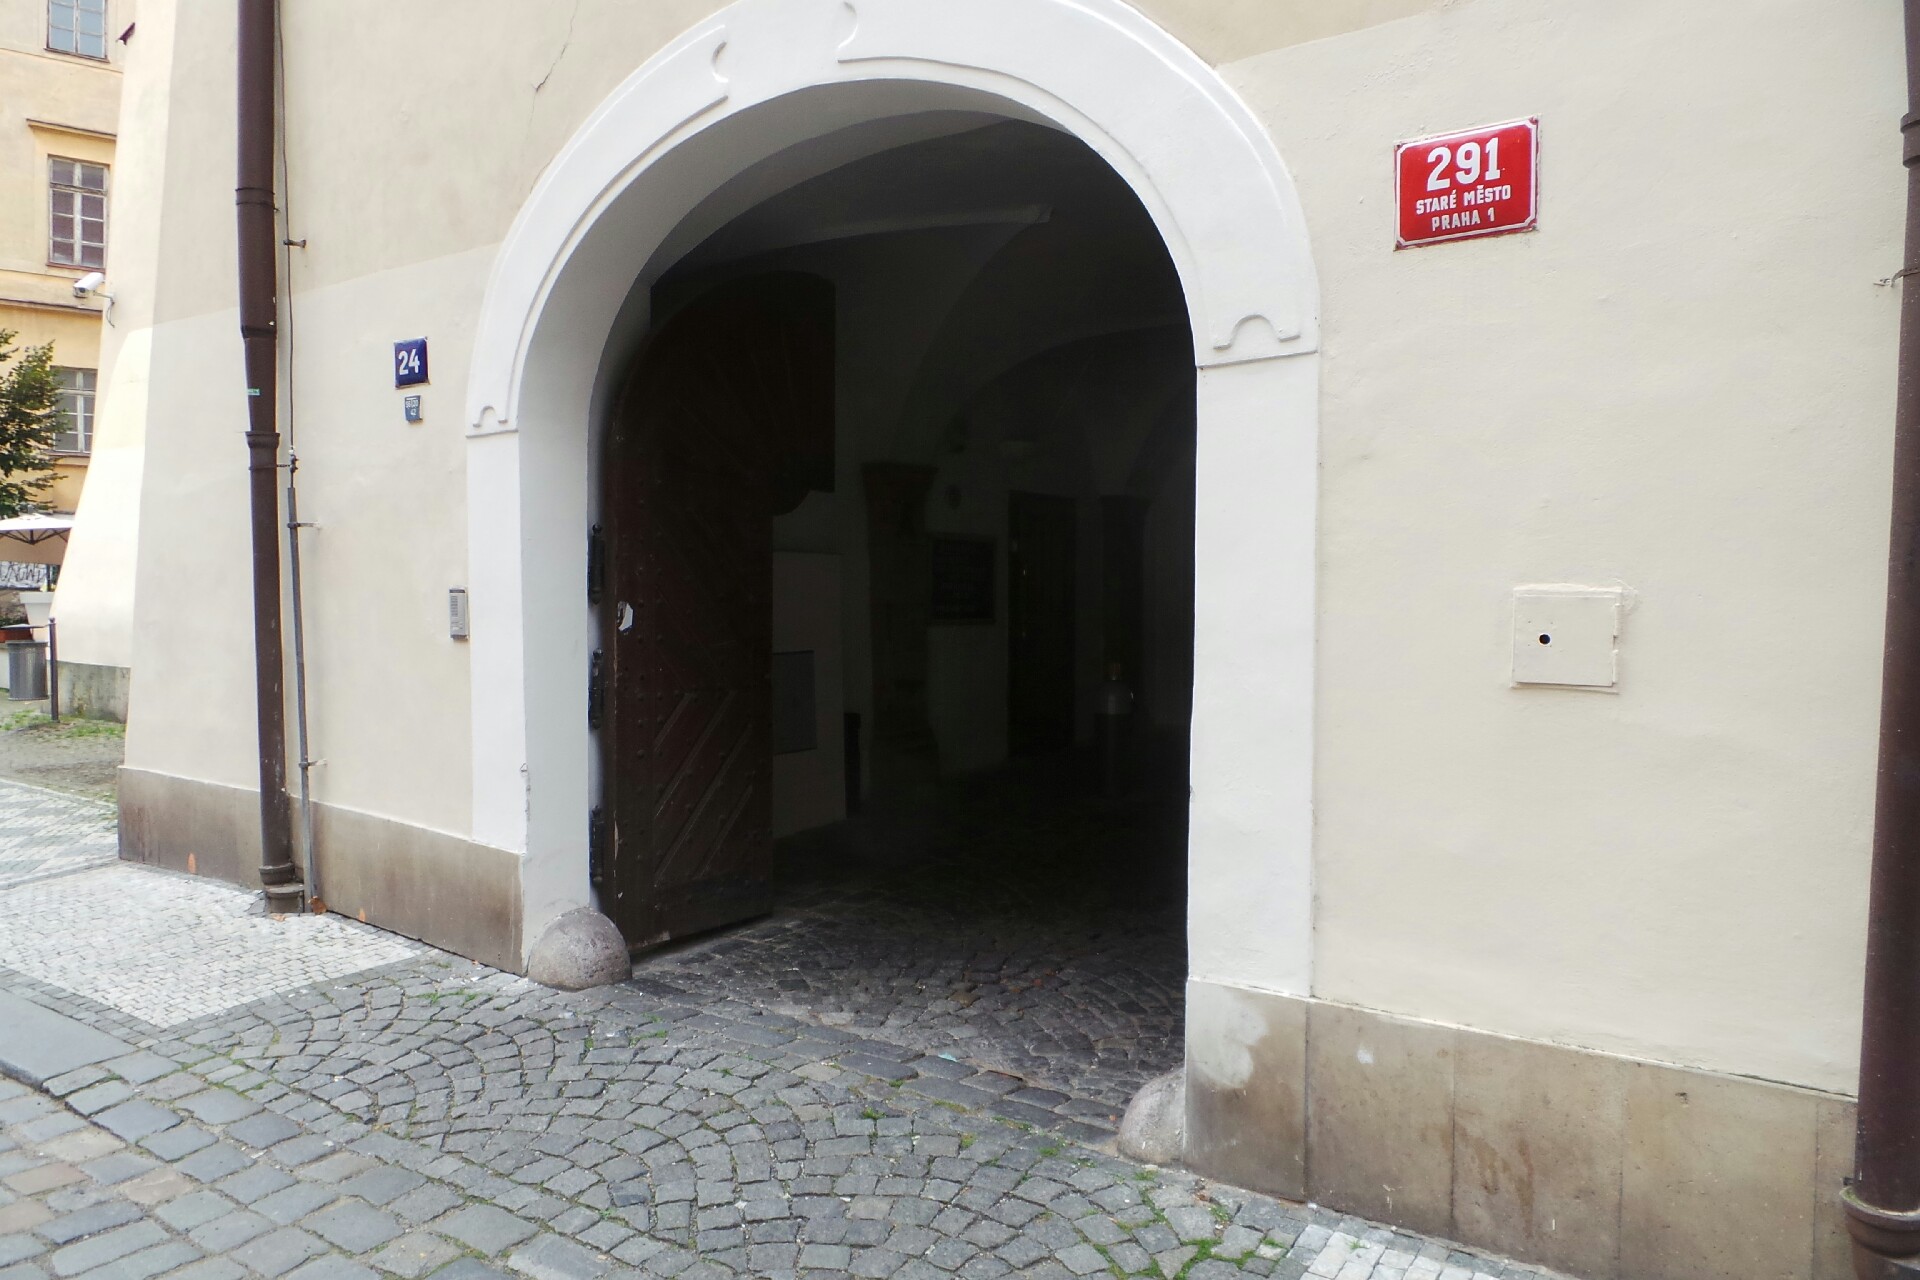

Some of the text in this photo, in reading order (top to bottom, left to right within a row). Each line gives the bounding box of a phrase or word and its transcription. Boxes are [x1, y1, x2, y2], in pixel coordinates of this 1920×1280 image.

[1426, 137, 1501, 192] 291
[1416, 184, 1511, 215] STARÉ MĚSTO
[1432, 207, 1495, 232] PRAHA 1
[398, 348, 420, 376] 24
